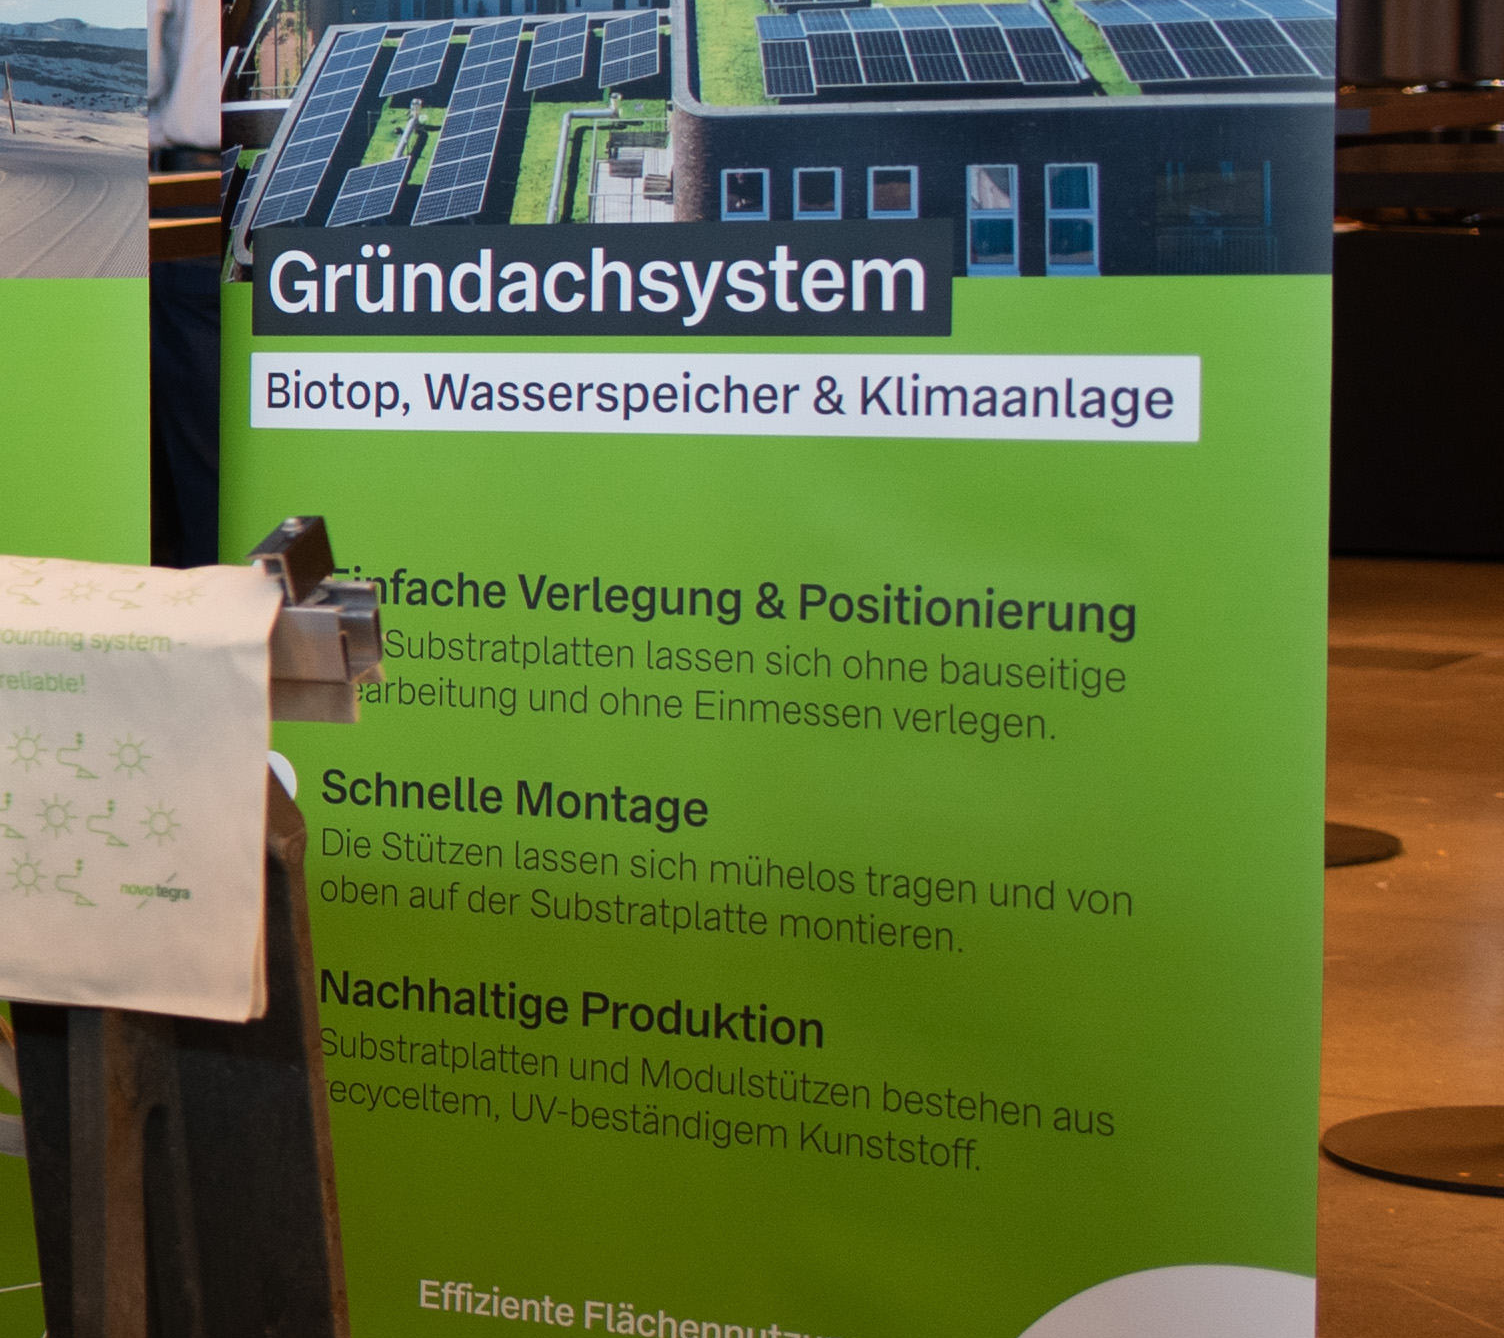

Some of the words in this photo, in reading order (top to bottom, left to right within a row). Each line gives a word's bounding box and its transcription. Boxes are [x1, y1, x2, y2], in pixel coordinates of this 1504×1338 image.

[269, 246, 927, 326] Gründachsystem
[266, 371, 411, 418] Biotop,
[425, 371, 799, 423] Wasserspeicher
[813, 376, 845, 414] &
[860, 375, 1174, 428] Klimaanlage
[518, 573, 743, 625] Verlegung
[757, 581, 786, 619] &
[799, 581, 1136, 642] Positionierung
[90, 633, 171, 653] system
[384, 628, 634, 672] Substratplatten
[646, 639, 755, 675] lassen
[765, 645, 832, 680] sich
[843, 649, 928, 684] ohne
[940, 655, 1126, 699] bauseitige
[529, 684, 589, 716] und
[600, 684, 683, 719] ohne
[694, 691, 883, 731] Einmessen
[893, 702, 1056, 744] verlegen.
[322, 767, 503, 816] Schnelle
[516, 780, 709, 833] Montage
[120, 883, 191, 901] novotegra
[322, 827, 372, 861] Die
[382, 831, 504, 870] Stützen
[515, 842, 619, 878] lassen
[629, 847, 697, 883] sich
[709, 855, 855, 897] mühelos
[866, 866, 977, 913] tragen
[990, 875, 1055, 913] und
[1066, 886, 1132, 917] von
[321, 873, 399, 909] oben
[409, 880, 461, 914] auf
[468, 883, 520, 917] der
[530, 888, 768, 939] Substratplatte
[779, 908, 964, 955] montieren.
[320, 969, 568, 1028] Nachhaltige
[582, 991, 825, 1050] Produktion
[321, 1027, 559, 1080] Substratplatten
[569, 1047, 629, 1088] und
[640, 1056, 871, 1111] Modulstützen
[882, 1083, 1042, 1133] bestehen
[1052, 1106, 1115, 1138] aus
[324, 1080, 499, 1123] ecyceltem,
[511, 1092, 788, 1152] UV-beständigem
[800, 1122, 981, 1173] Kunststoff.
[419, 1278, 575, 1328] Effiziente
